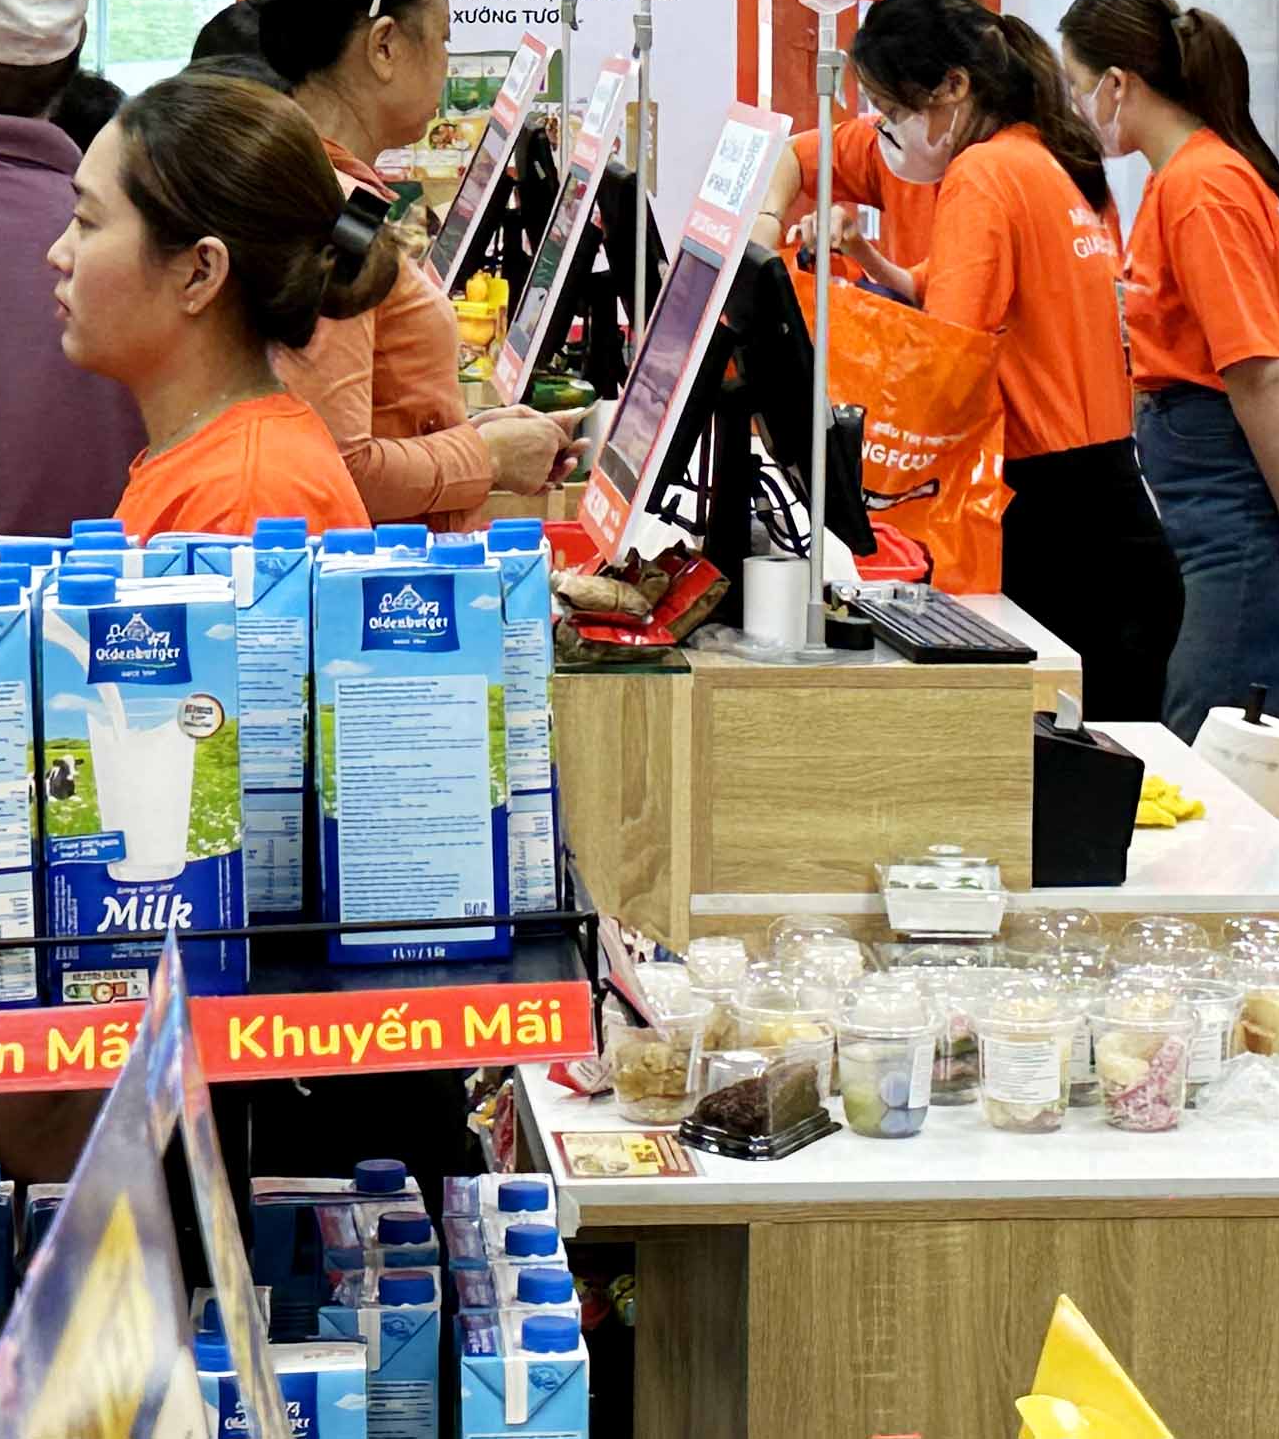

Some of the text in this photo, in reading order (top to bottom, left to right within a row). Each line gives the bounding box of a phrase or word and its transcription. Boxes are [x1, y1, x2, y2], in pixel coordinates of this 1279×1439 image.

[368, 616, 449, 631] Oldenburger
[96, 893, 193, 933] Milk
[47, 1020, 135, 1073] Mã
[229, 999, 563, 1064] Khuyến Mãi
